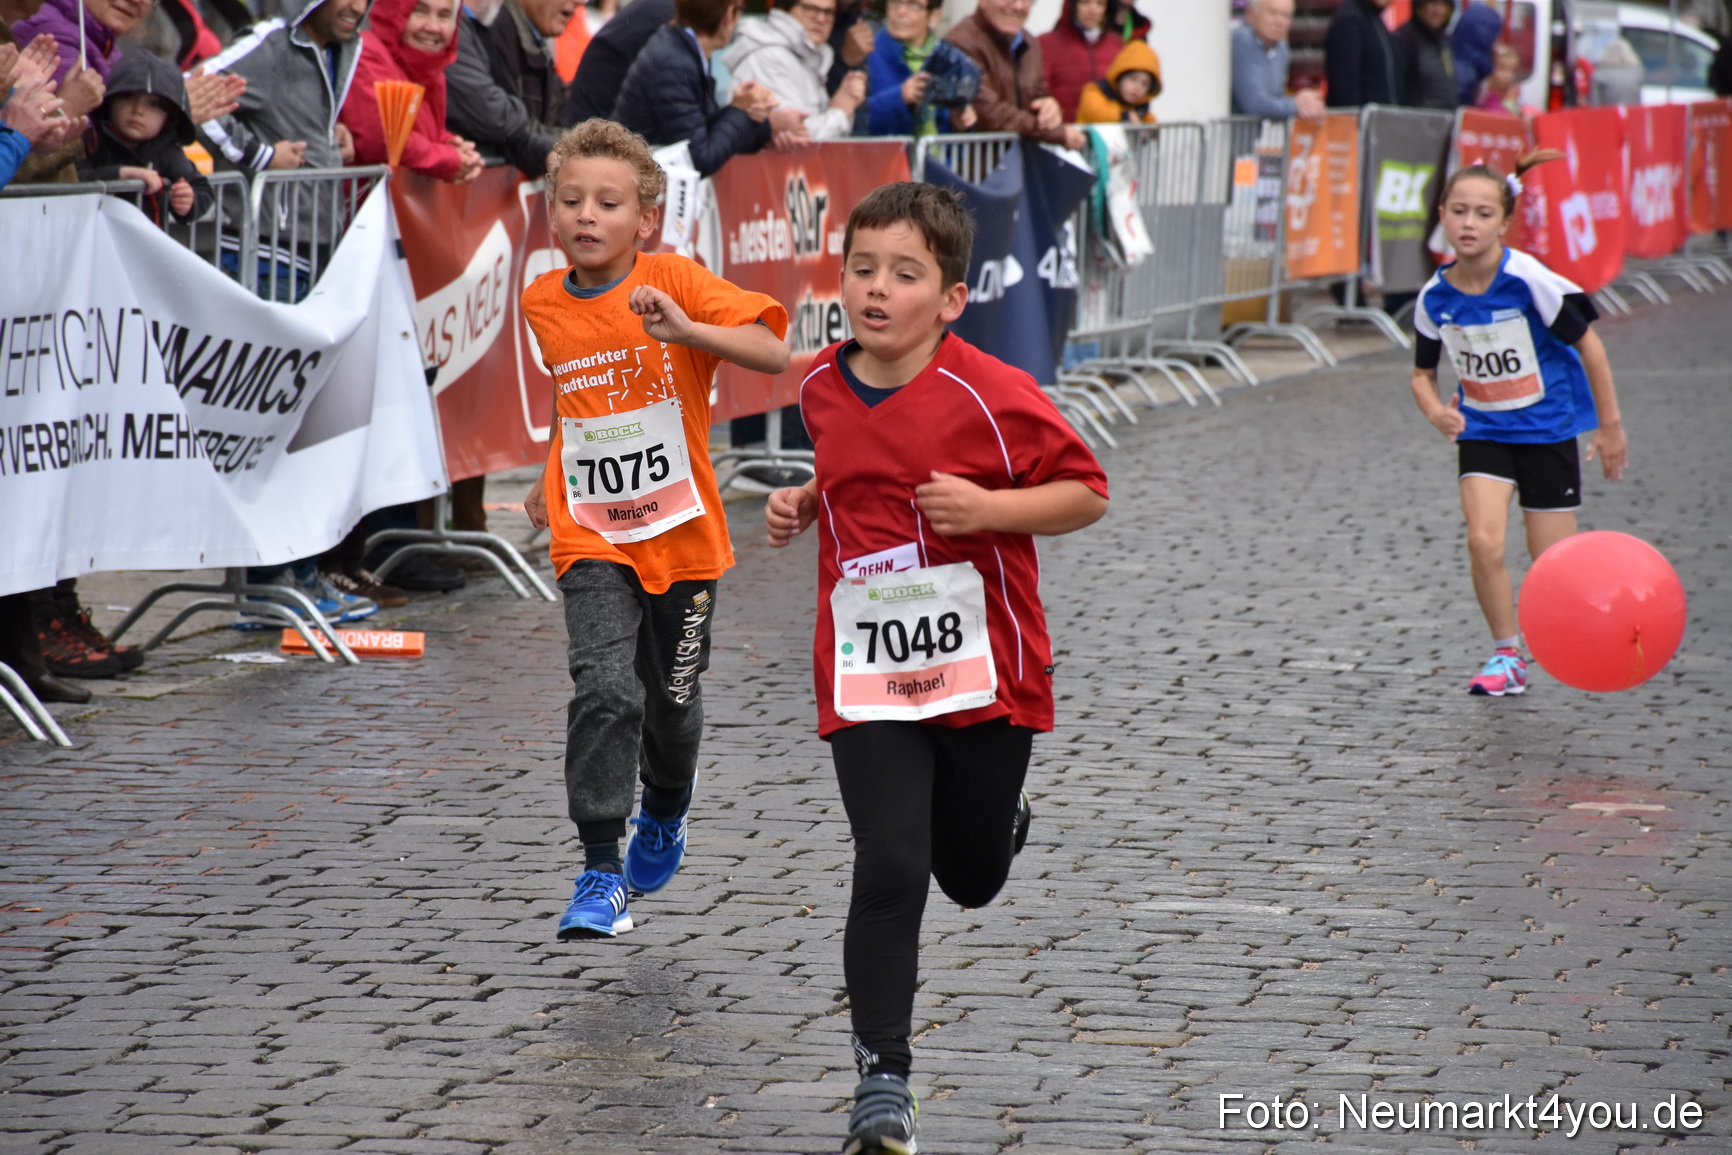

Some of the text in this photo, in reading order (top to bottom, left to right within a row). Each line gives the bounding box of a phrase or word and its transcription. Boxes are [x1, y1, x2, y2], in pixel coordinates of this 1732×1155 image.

[424, 306, 457, 369] AS
[461, 254, 504, 353] NEUE
[6, 307, 322, 415] EFFICENTYNAMICS.
[552, 348, 628, 376] Neumarkter
[1459, 348, 1522, 378] 7206
[596, 421, 644, 441] BOCK
[576, 443, 670, 495] 7075
[572, 490, 582, 498] B6
[607, 501, 659, 521] Mariano
[881, 583, 937, 601] BOCK
[317, 631, 404, 648] BRANDIG
[855, 612, 963, 664] 7048
[842, 660, 854, 668] B6
[886, 673, 946, 698] Raphael
